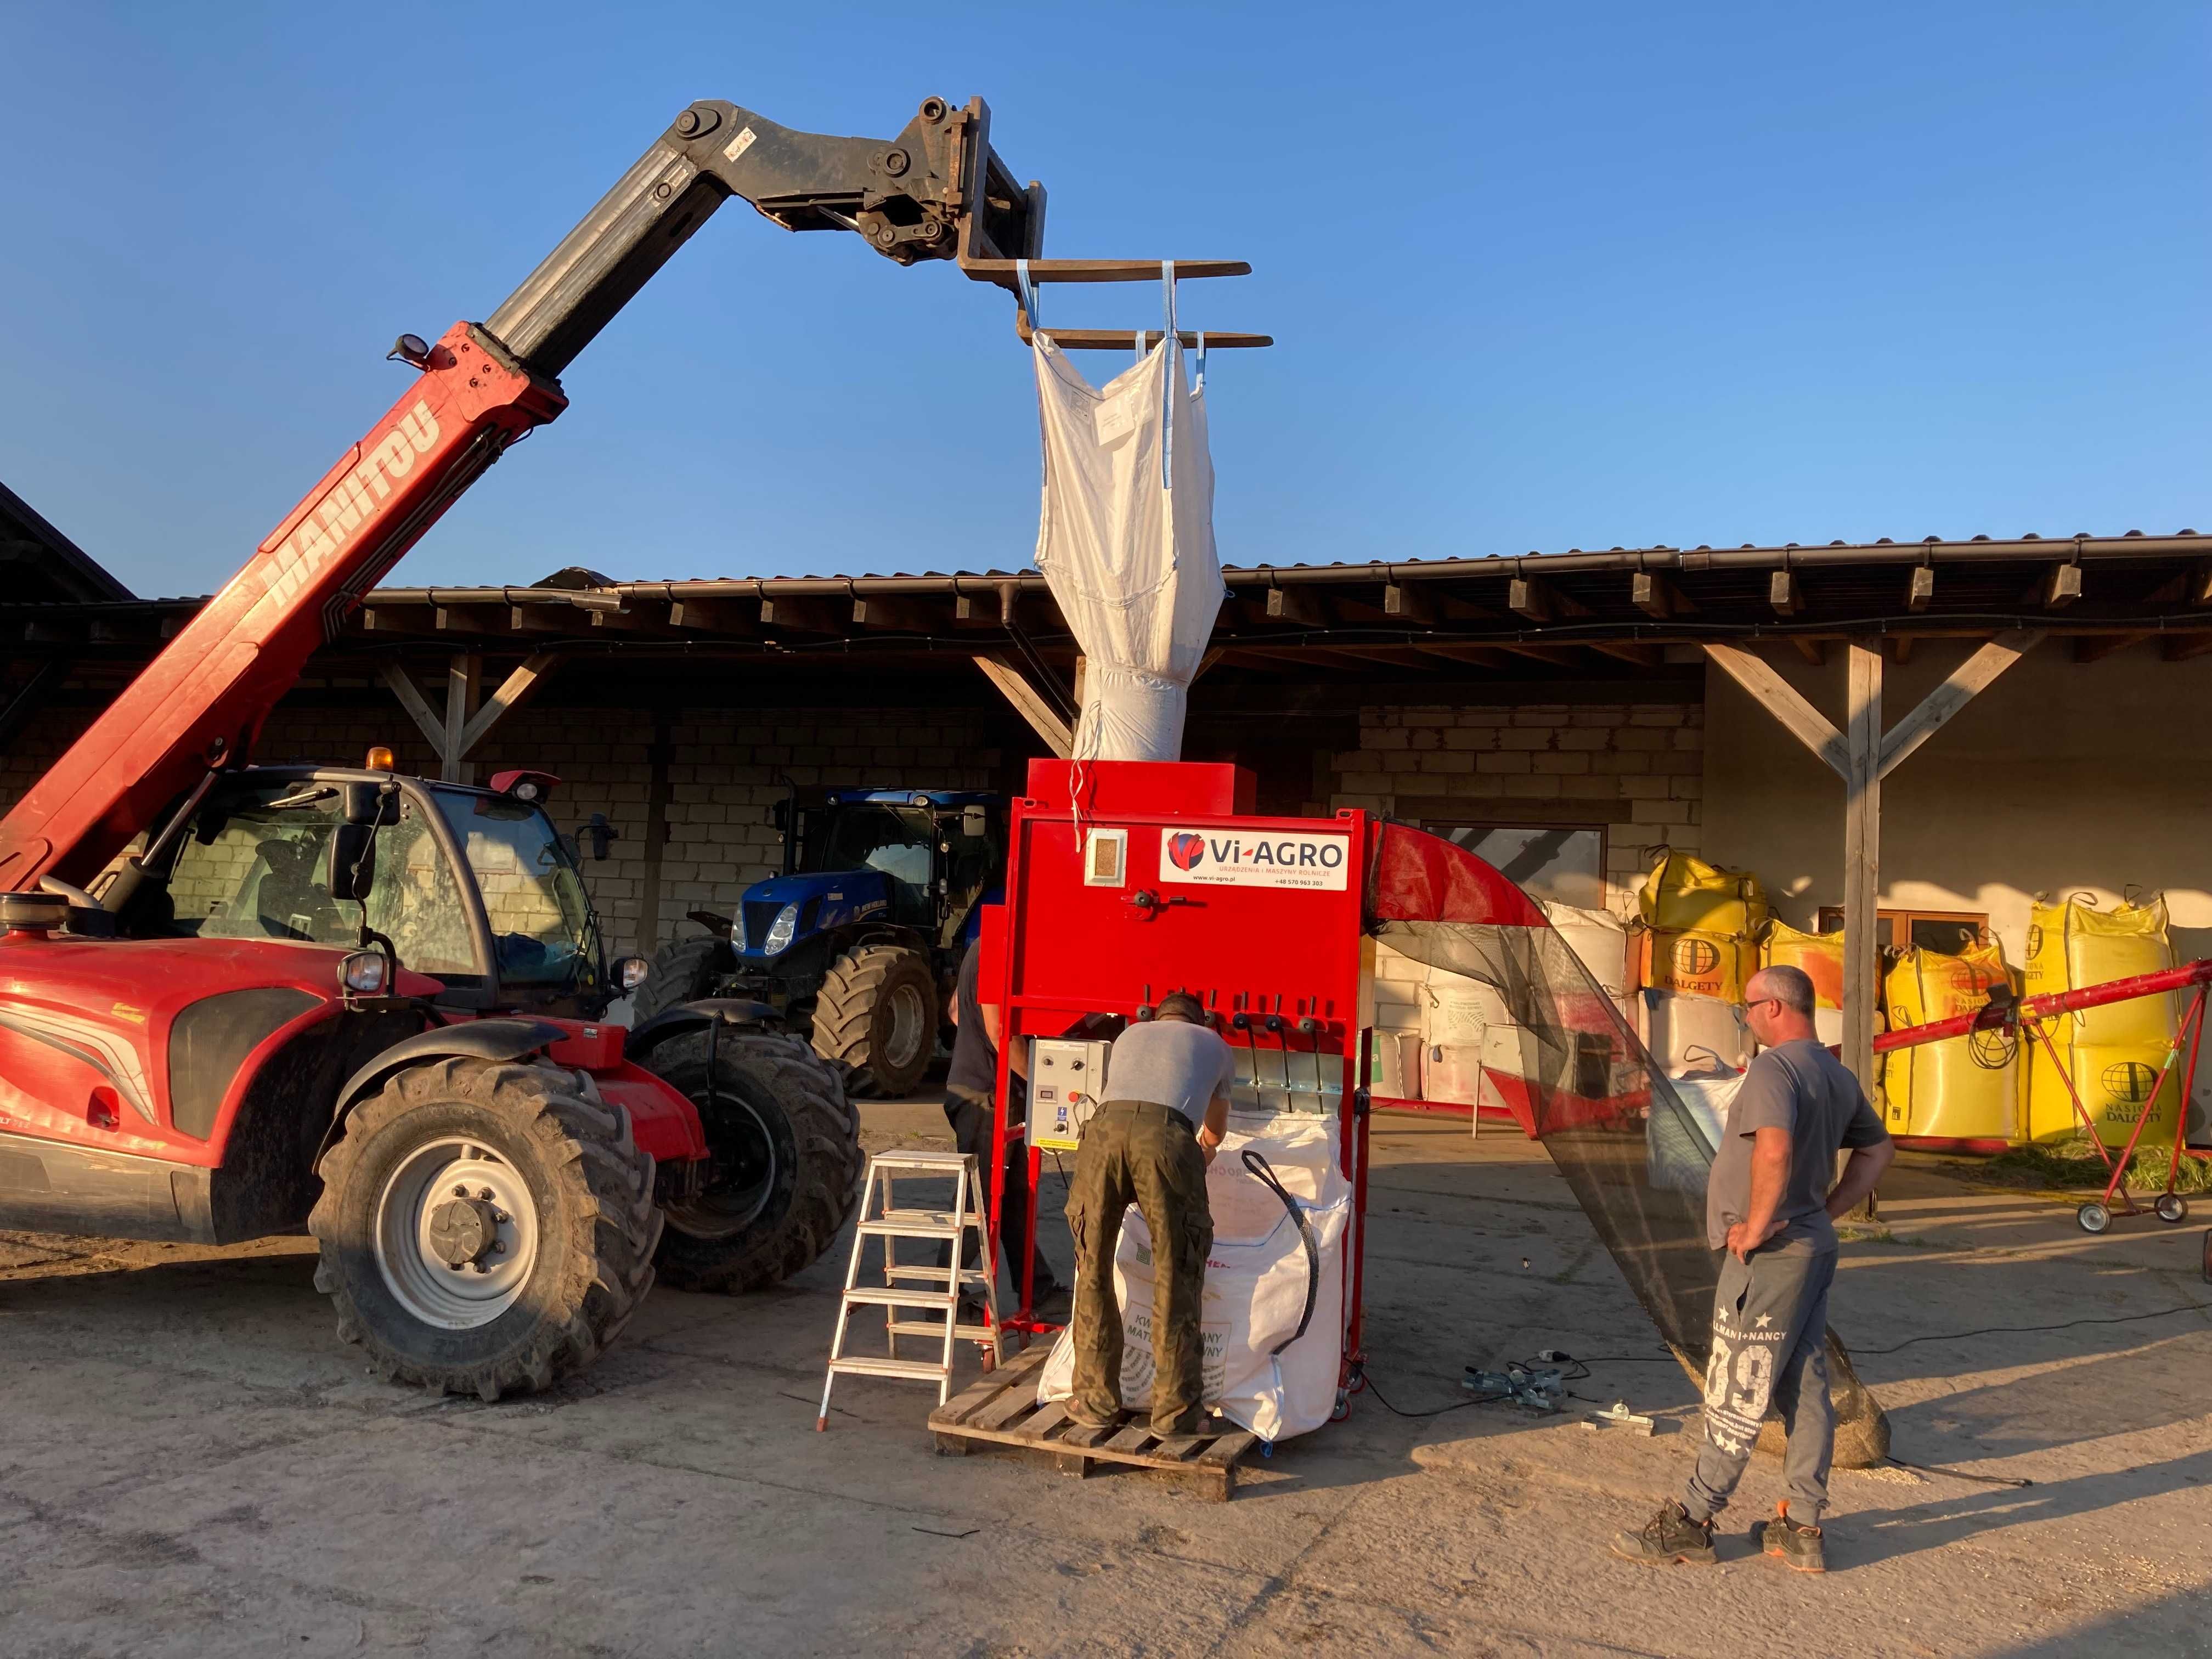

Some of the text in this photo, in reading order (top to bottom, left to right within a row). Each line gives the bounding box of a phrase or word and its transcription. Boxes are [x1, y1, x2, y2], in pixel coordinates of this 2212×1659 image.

[259, 400, 439, 608] MANITOU
[1664, 975, 1723, 991] DALGETY
[2105, 1103, 2162, 1113] NASIOA
[2106, 1112, 2162, 1124] DALGTY
